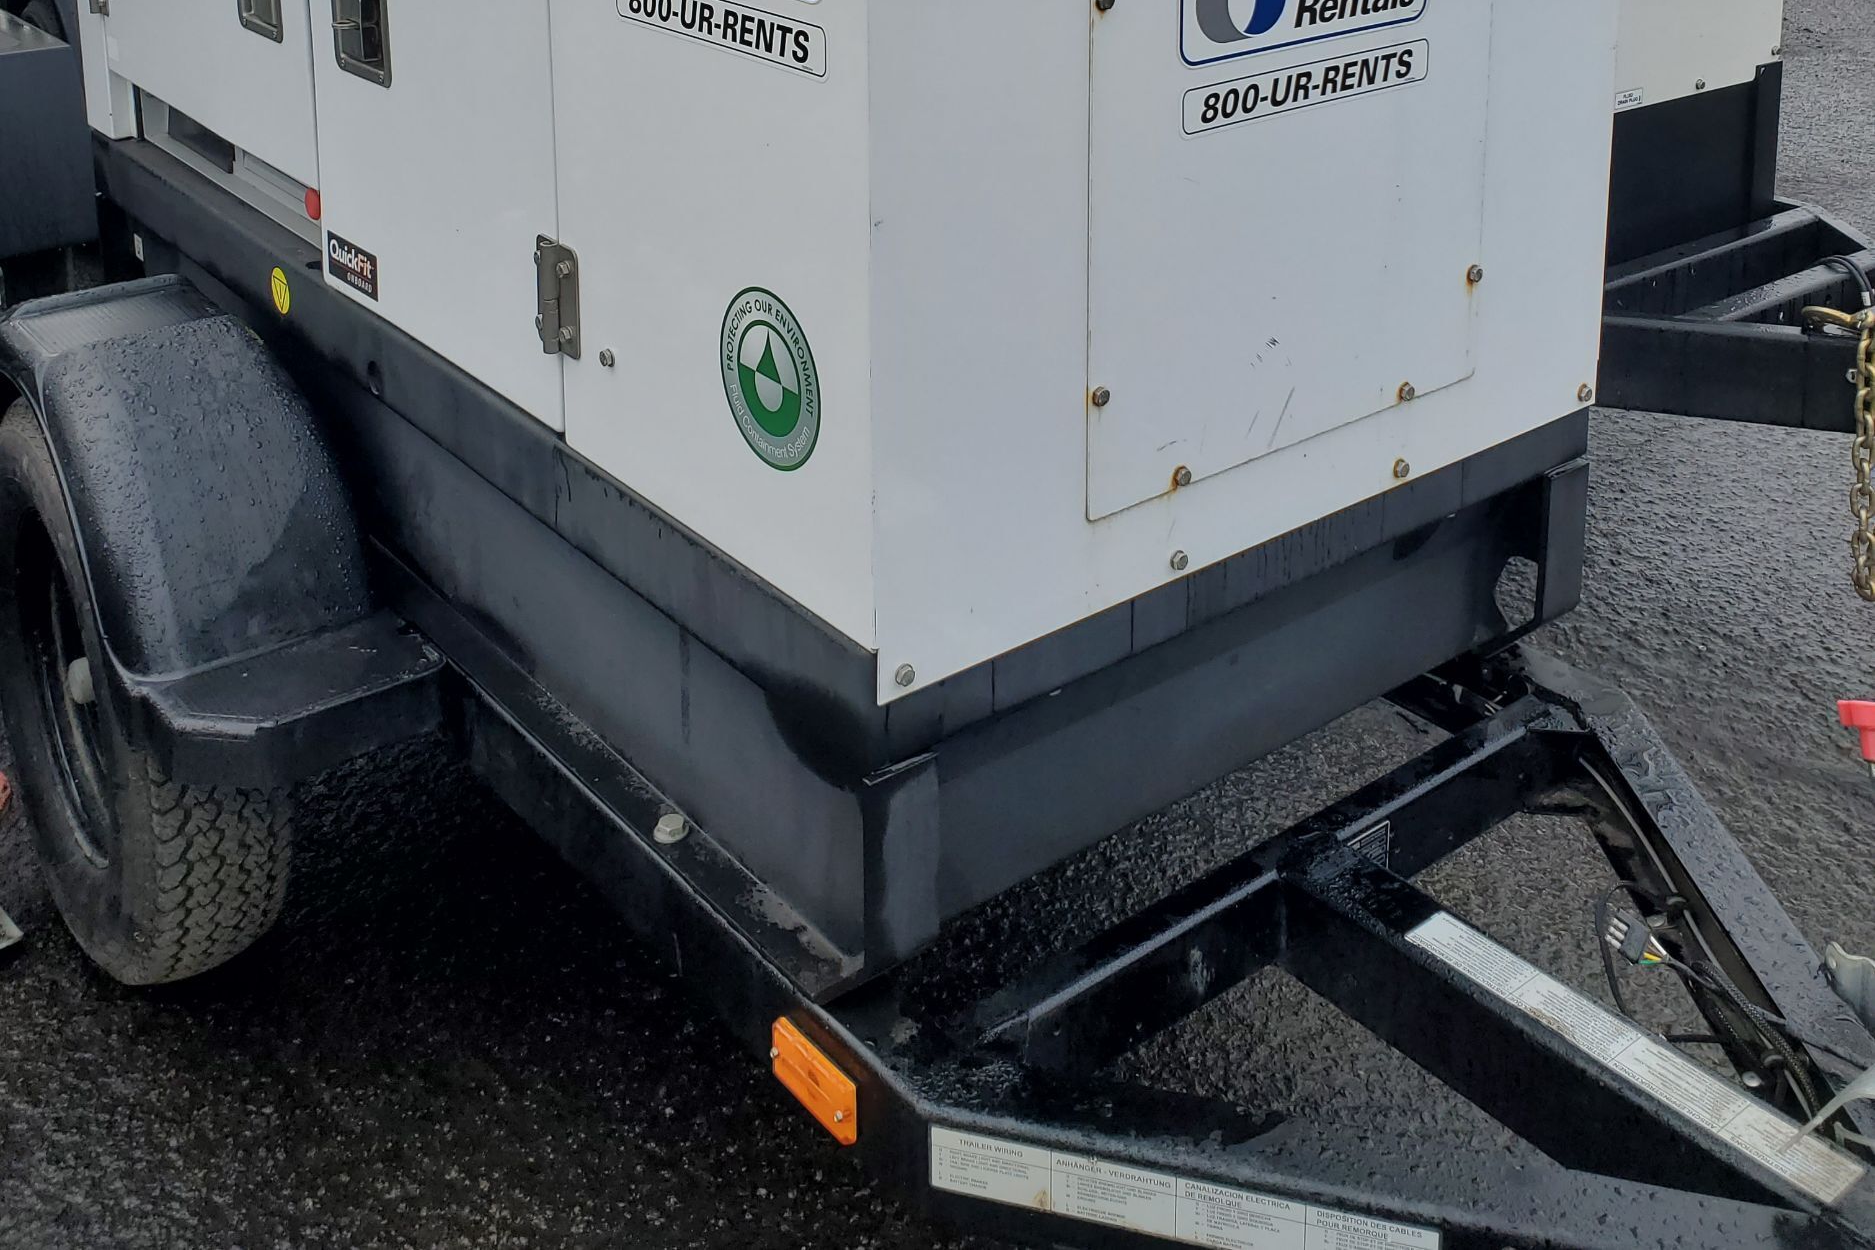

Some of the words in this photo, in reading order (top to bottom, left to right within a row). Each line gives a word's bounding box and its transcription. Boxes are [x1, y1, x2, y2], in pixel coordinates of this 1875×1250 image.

[1200, 48, 1413, 124] 800-UR-RENTS
[329, 238, 372, 279] QuickFit
[727, 300, 753, 372] PROTECTING
[754, 299, 773, 317] OUR
[775, 308, 814, 418] ENVIRONMENT
[729, 384, 745, 416] Fluid
[742, 415, 789, 459] Containment
[787, 426, 810, 458] System
[959, 1139, 992, 1151] TRAILER
[994, 1146, 1023, 1158] WIRING
[1108, 1169, 1171, 1189] VERDRAHTUNG
[1185, 1182, 1244, 1200] CANALIZACION
[1246, 1196, 1291, 1210] ELECTRICA
[1317, 1210, 1368, 1227] DISPOSITION
[1371, 1222, 1387, 1231] DES
[1389, 1225, 1423, 1238] CABLES
[1317, 1220, 1340, 1230] POUR
[1342, 1223, 1388, 1239] REMORQUE
